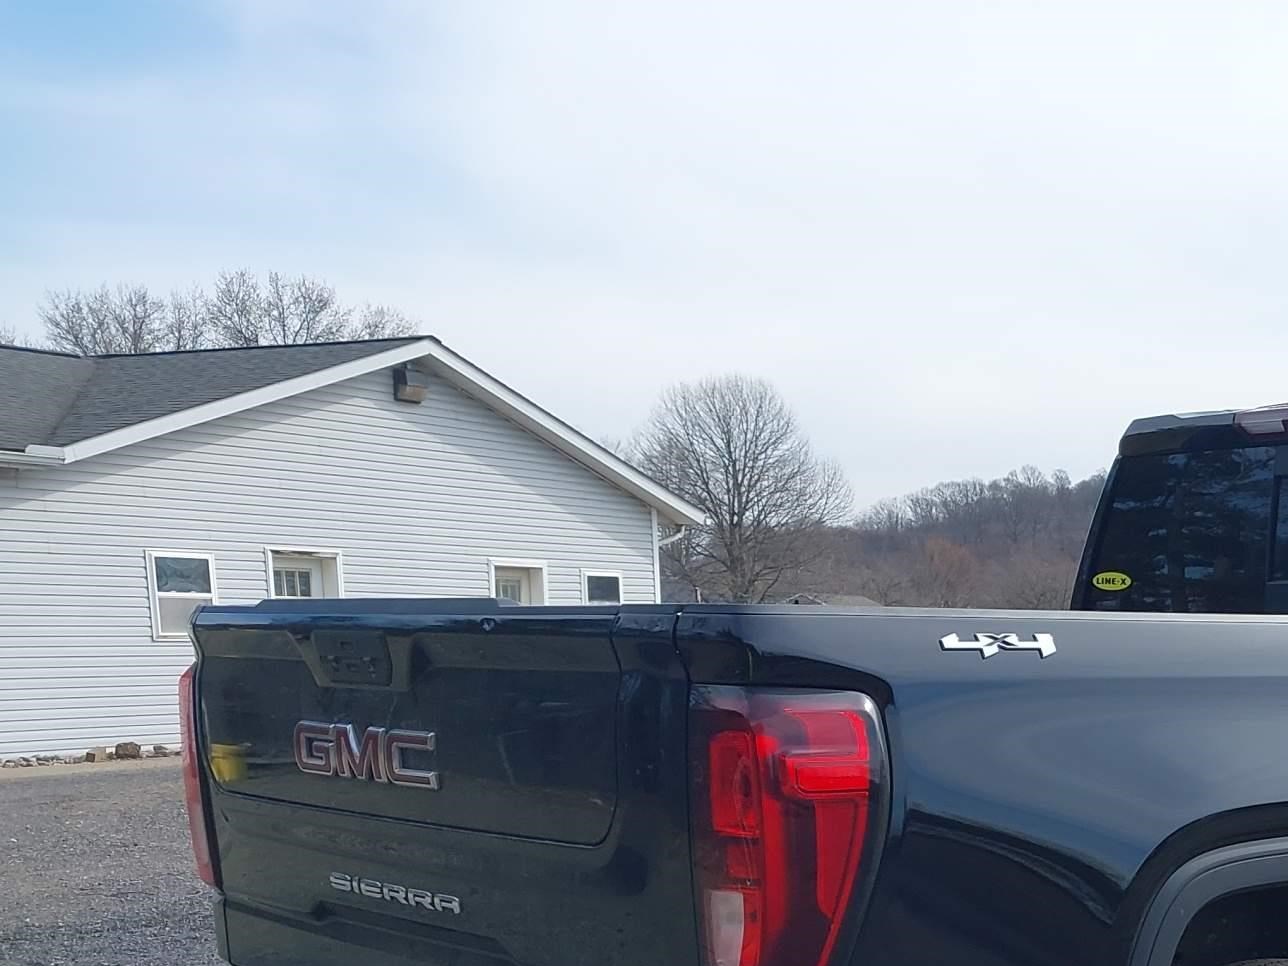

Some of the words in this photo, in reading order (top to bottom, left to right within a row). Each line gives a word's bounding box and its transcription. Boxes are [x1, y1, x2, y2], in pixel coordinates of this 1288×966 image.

[1096, 577, 1127, 585] LINE-X
[294, 720, 441, 791] GMC
[329, 871, 461, 915] SIERRA
